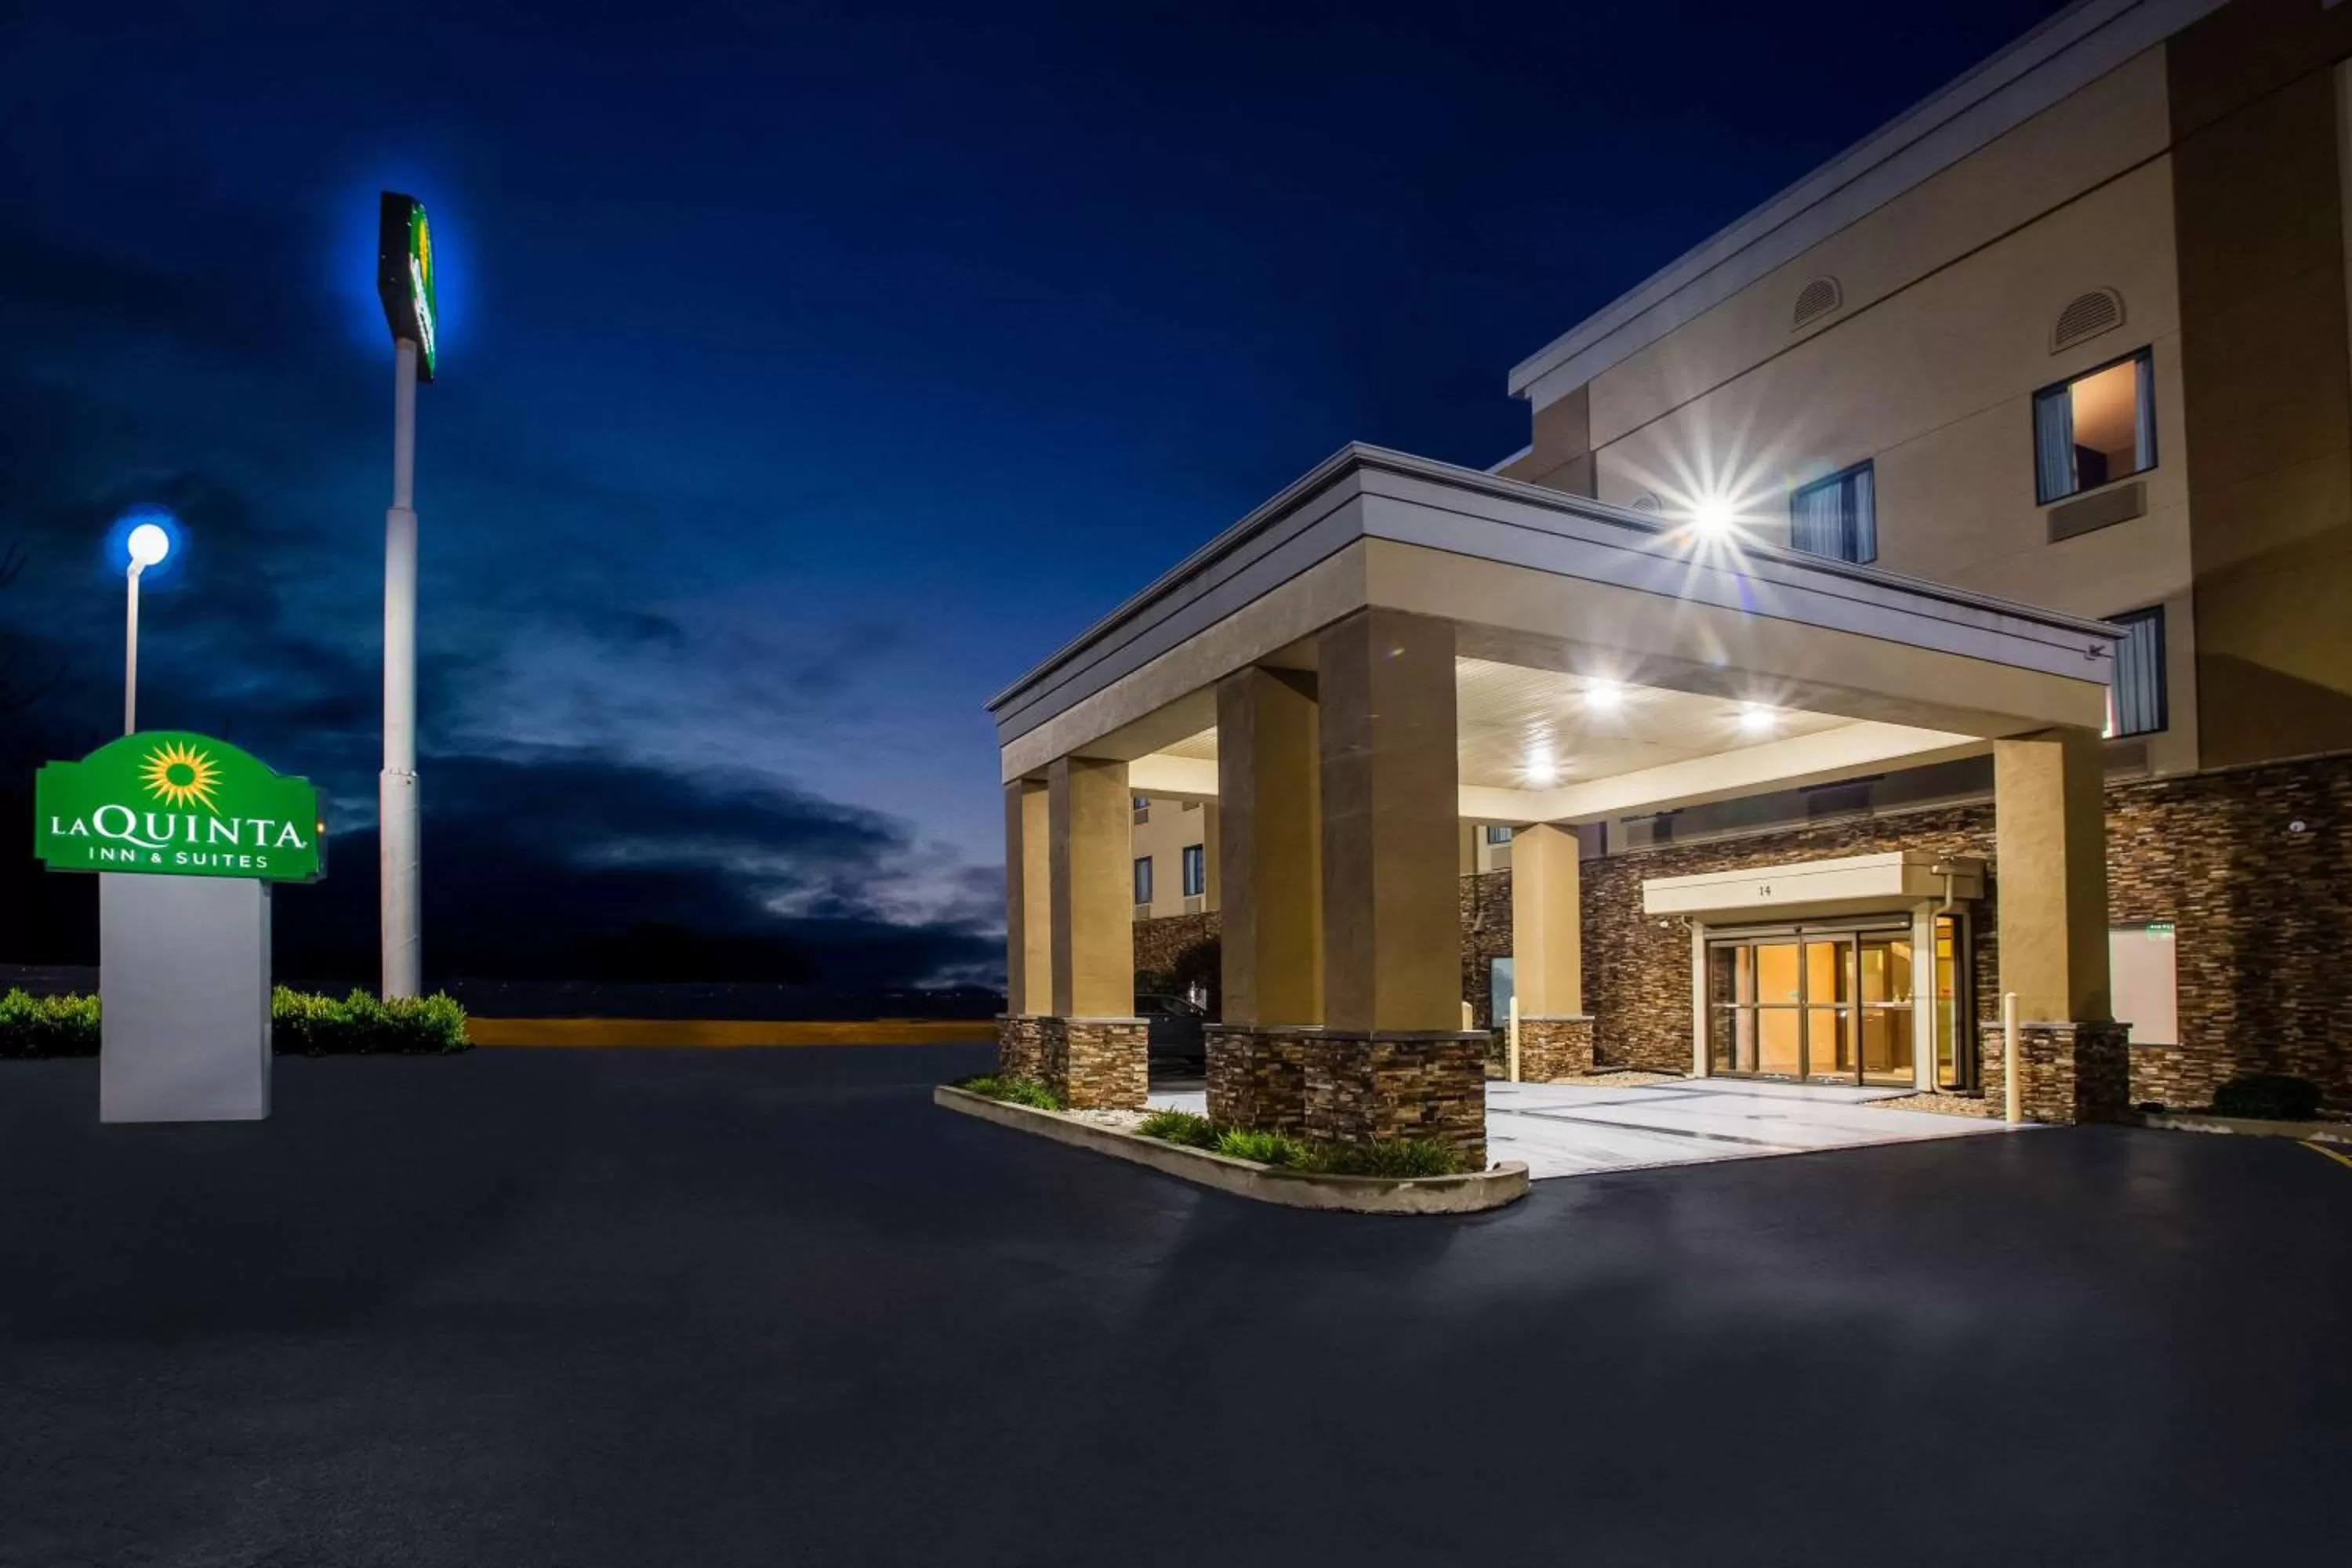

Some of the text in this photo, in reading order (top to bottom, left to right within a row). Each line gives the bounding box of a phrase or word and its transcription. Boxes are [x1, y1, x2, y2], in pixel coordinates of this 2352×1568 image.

[51, 804, 305, 848] LA QUINTA
[89, 847, 267, 869] INN & SUITES
[1759, 885, 1772, 897] 14
